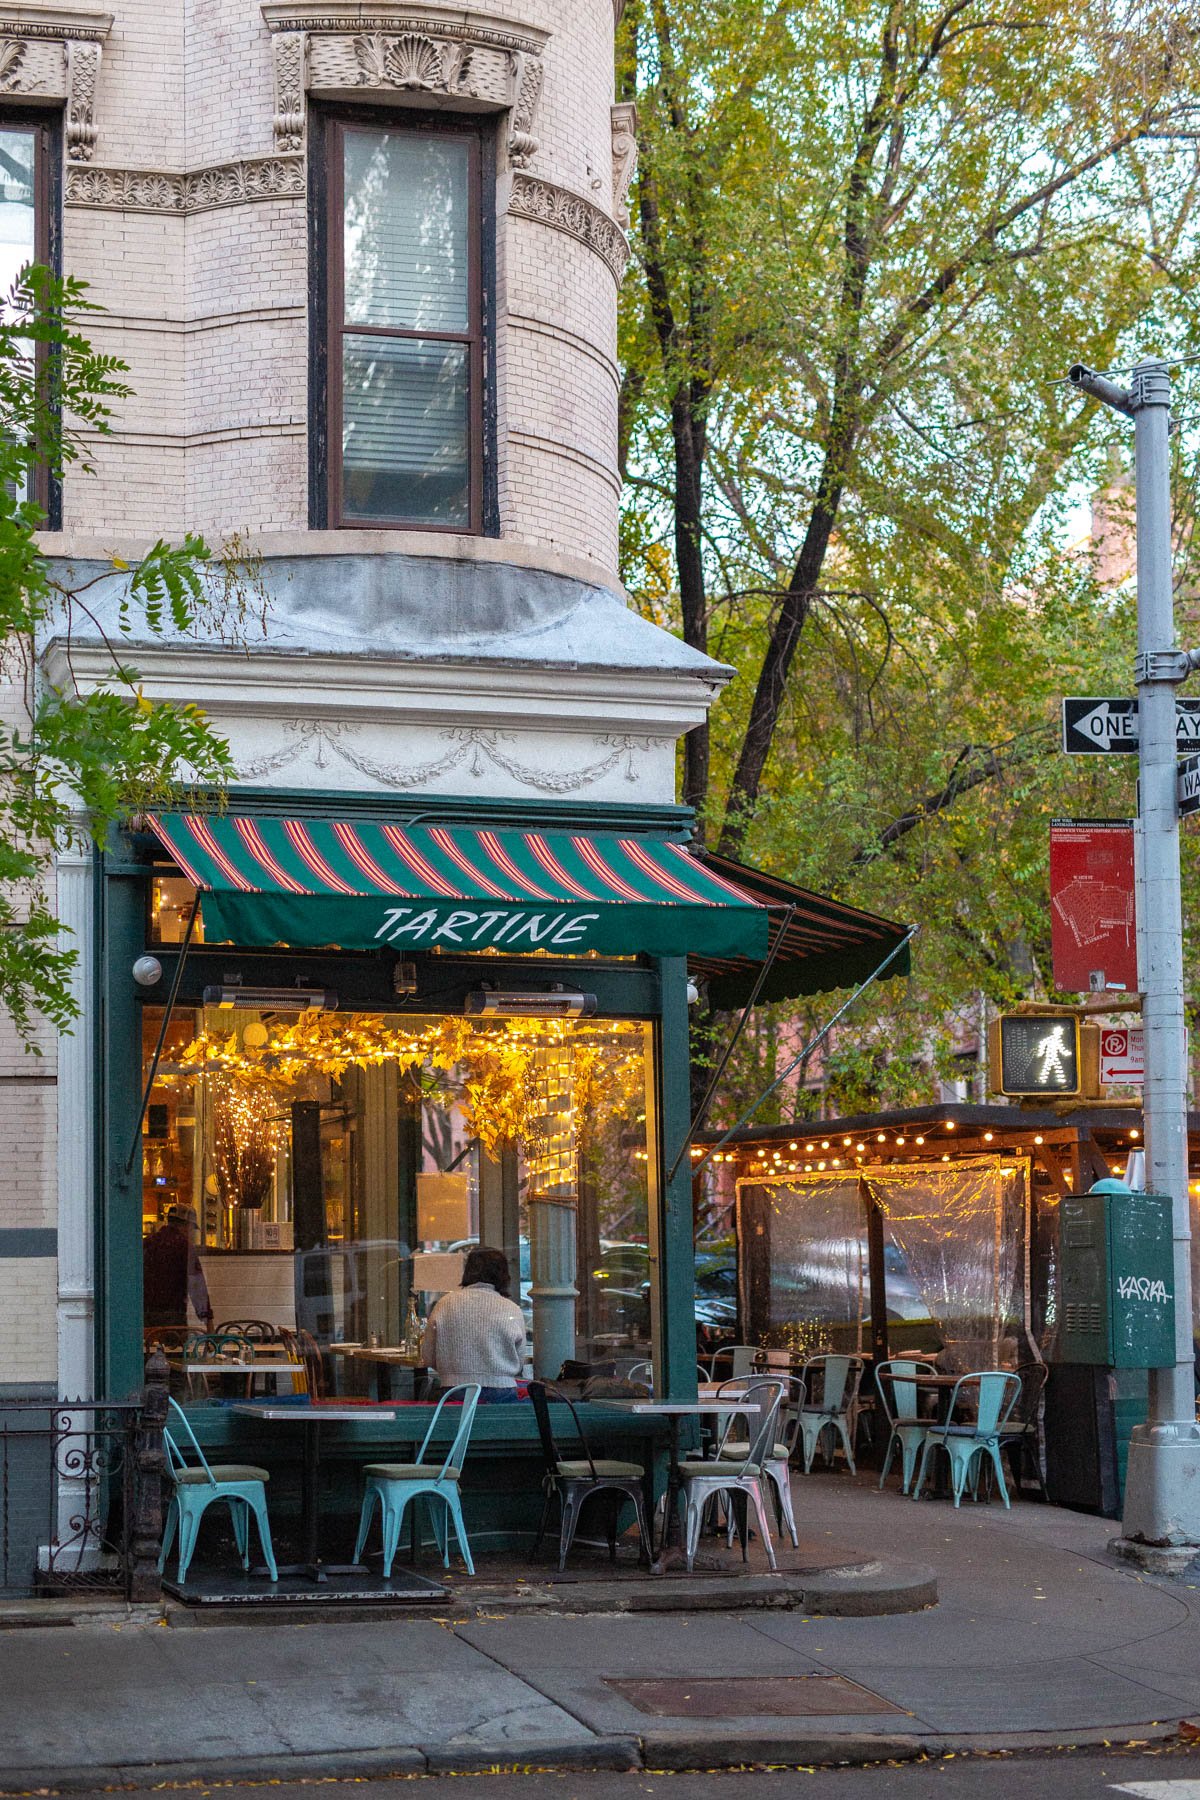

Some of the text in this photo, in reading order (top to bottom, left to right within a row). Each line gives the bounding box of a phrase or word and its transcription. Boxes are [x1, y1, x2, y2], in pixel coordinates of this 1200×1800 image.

[1090, 716, 1200, 736] ONE AY
[373, 908, 600, 944] TARTINE
